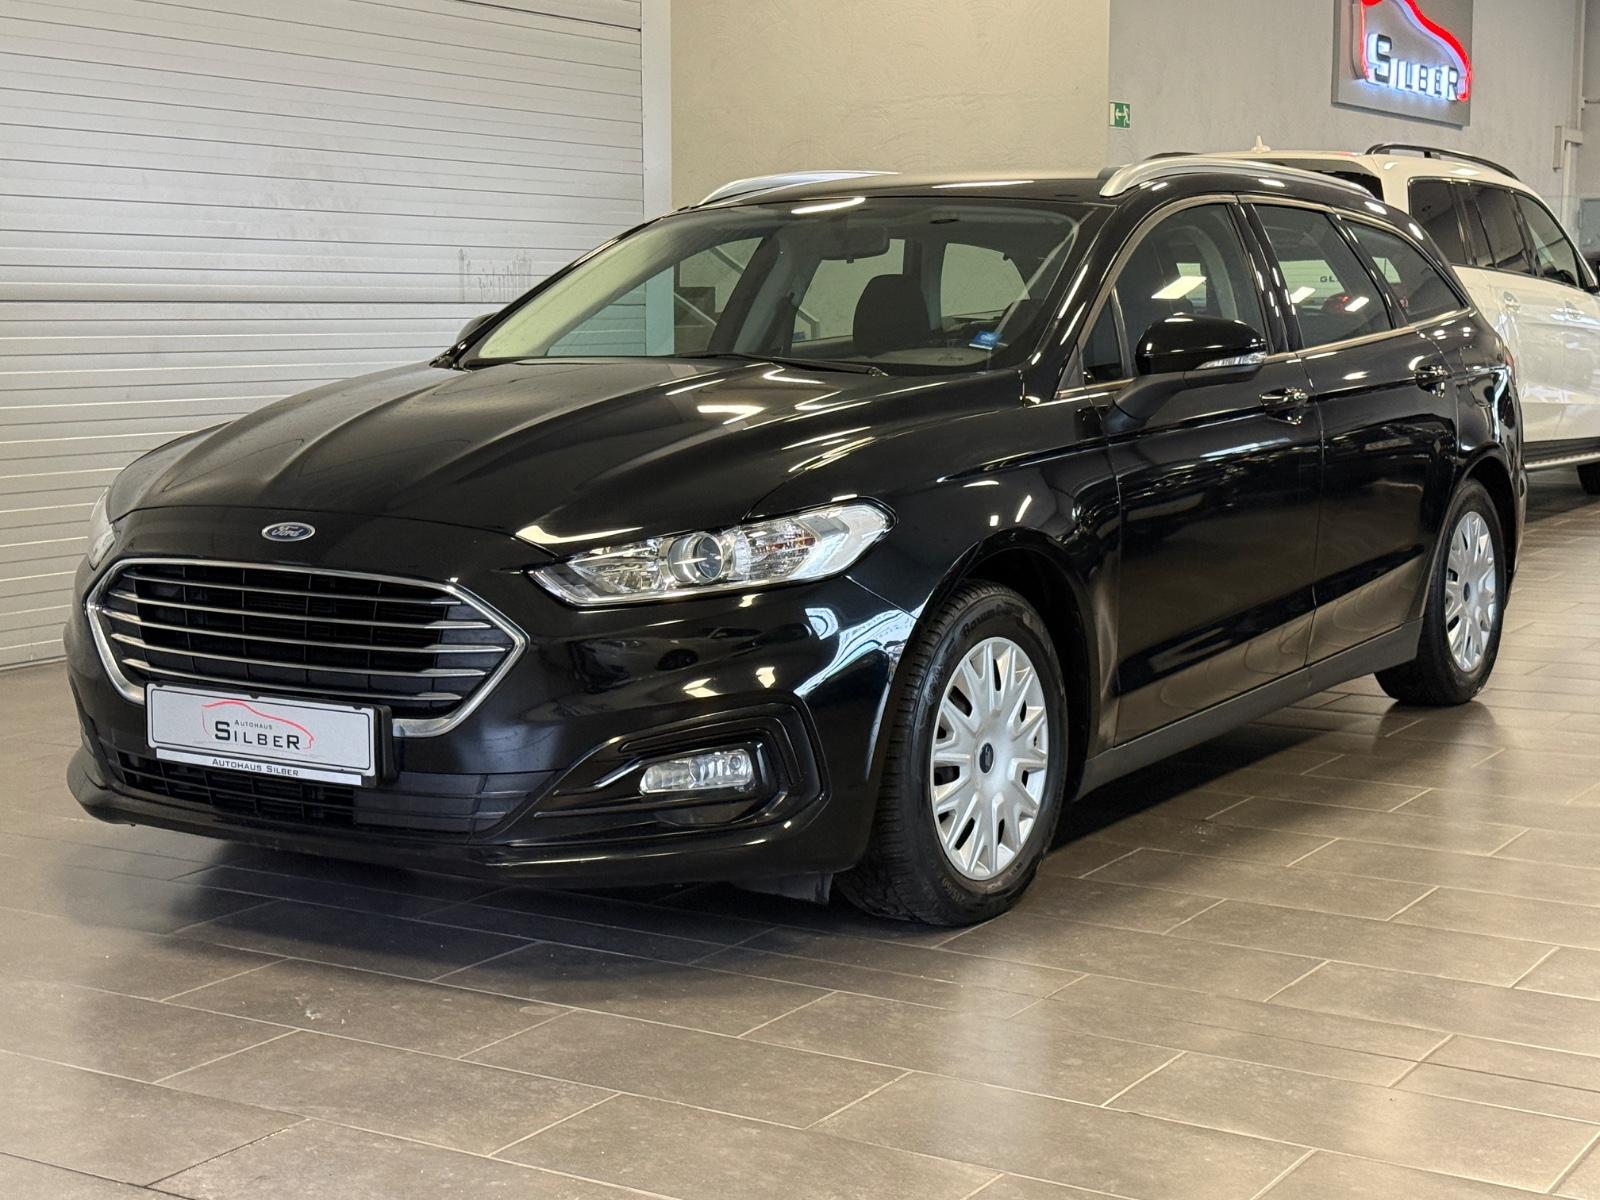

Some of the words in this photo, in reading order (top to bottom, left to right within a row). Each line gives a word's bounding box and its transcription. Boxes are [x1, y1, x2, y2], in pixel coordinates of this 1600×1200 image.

[1367, 32, 1460, 101] SILBER
[214, 720, 300, 750] SILBER
[234, 719, 273, 730] AUTOHAUS
[212, 758, 262, 772] AUTOHAUS
[266, 765, 299, 777] SILBER
